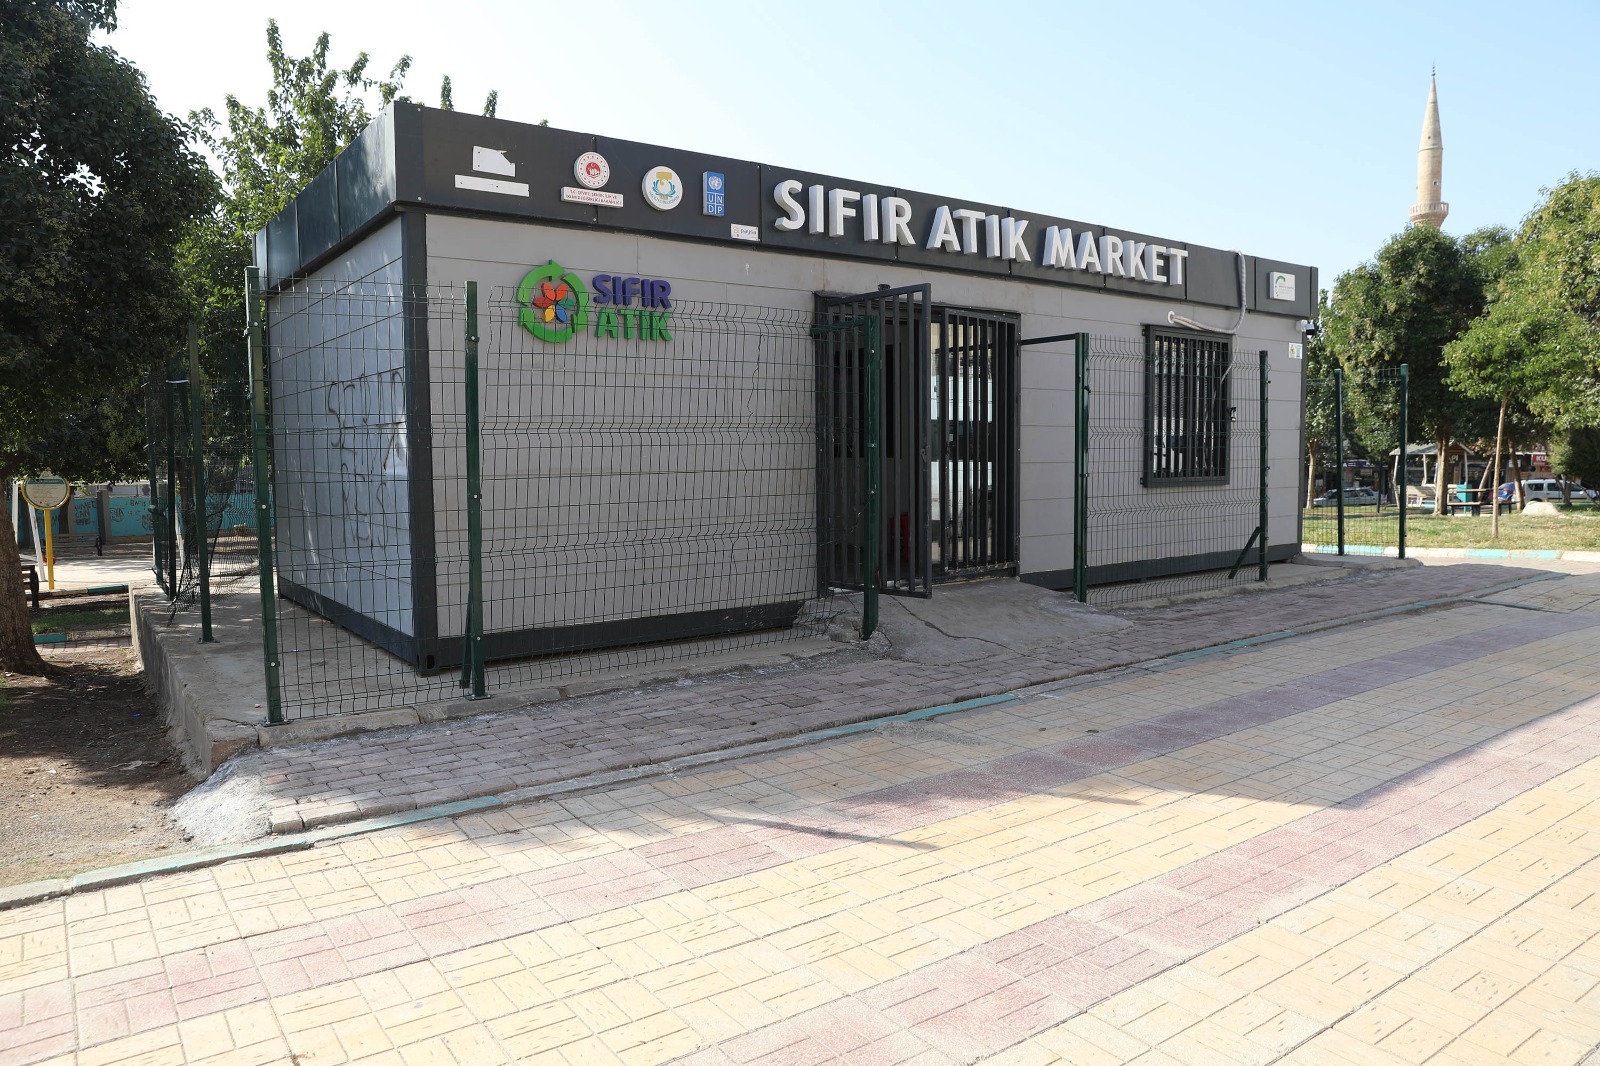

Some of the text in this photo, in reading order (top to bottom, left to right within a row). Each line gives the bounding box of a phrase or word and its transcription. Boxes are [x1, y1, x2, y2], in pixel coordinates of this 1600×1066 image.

[773, 179, 1189, 286] SIFIR ATIK MARKET
[592, 273, 672, 309] SIFIR
[595, 308, 673, 341] ATIK
